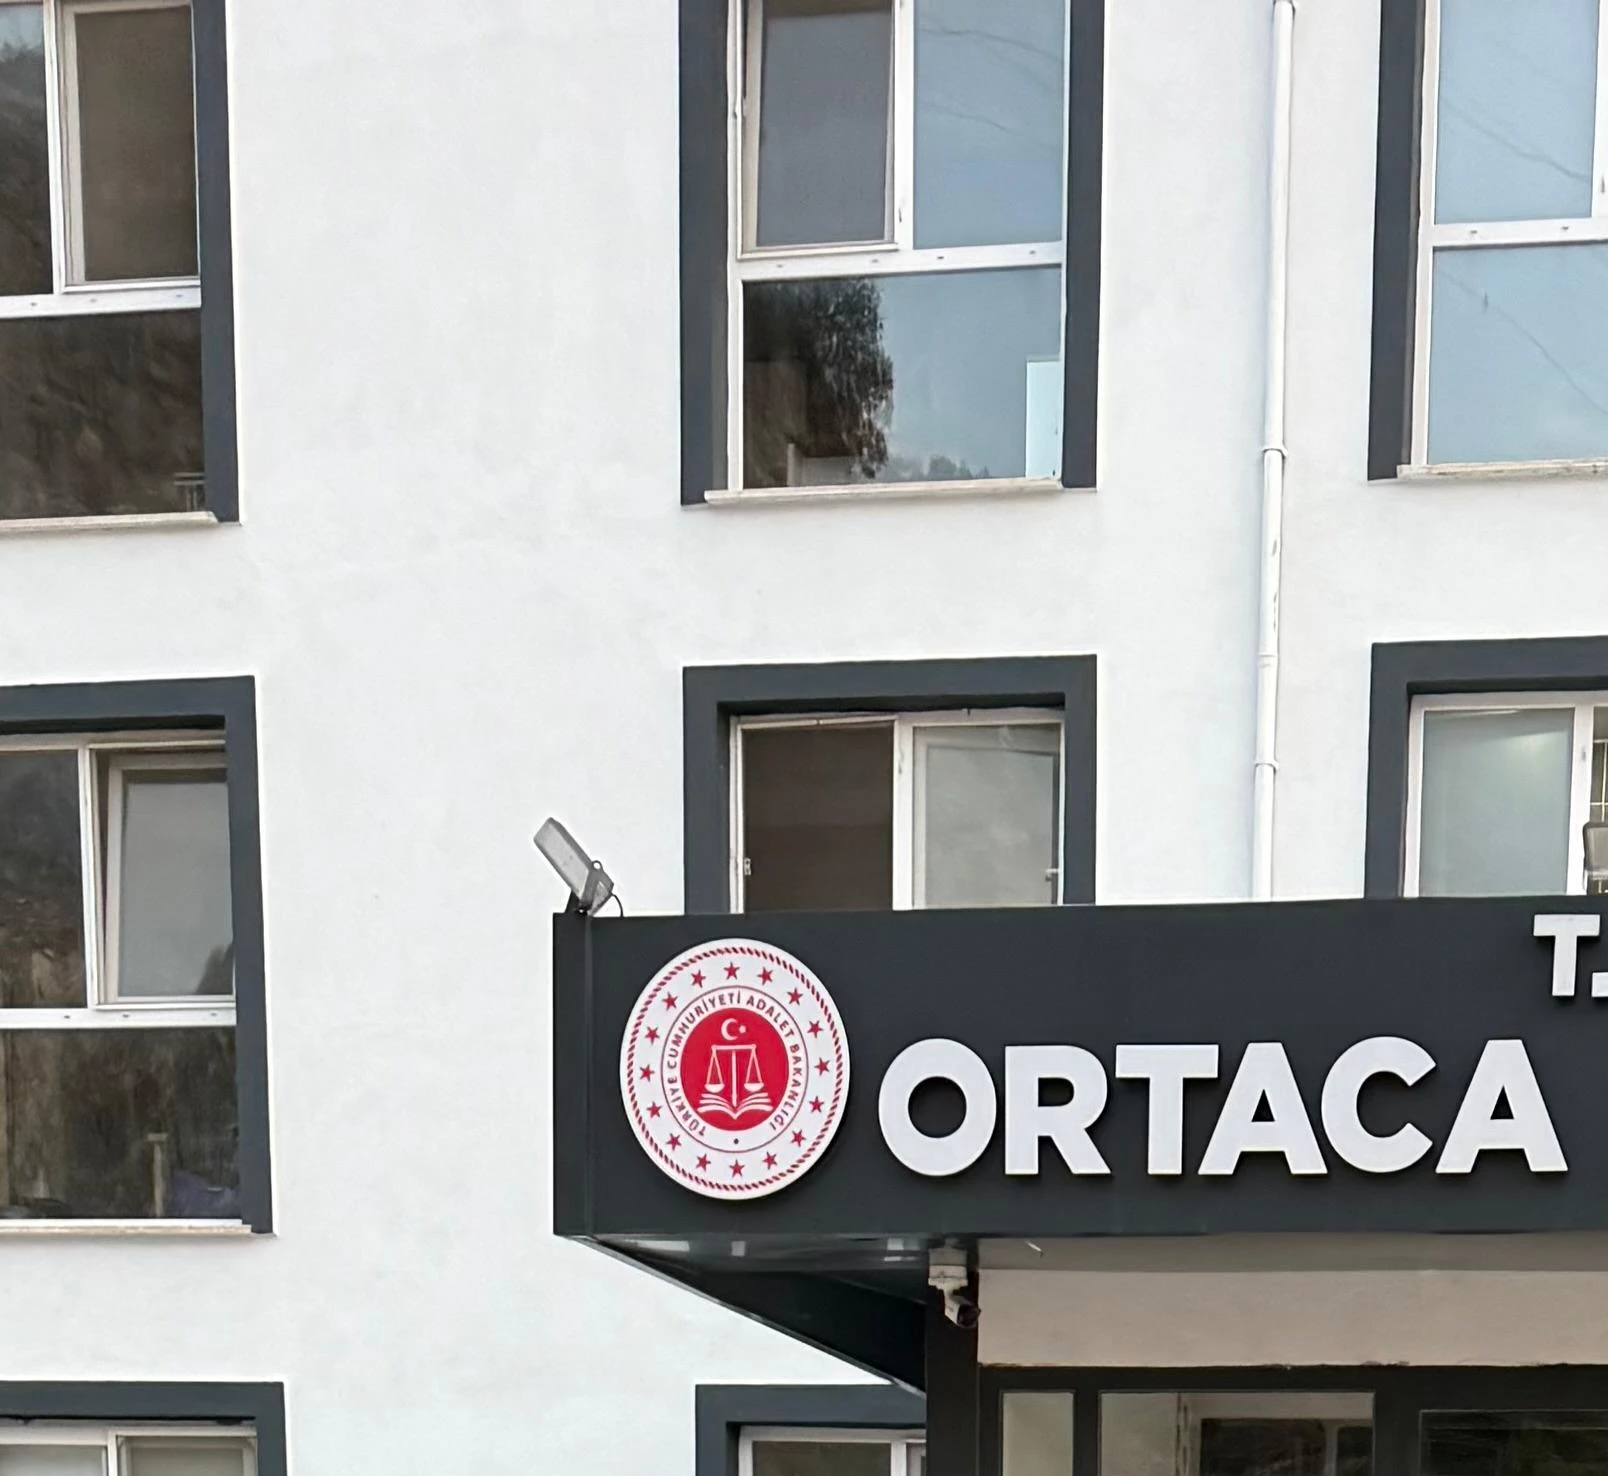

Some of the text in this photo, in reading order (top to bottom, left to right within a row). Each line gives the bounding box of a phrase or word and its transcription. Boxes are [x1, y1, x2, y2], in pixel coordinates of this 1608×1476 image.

[668, 989, 742, 1069] CUMHURİYETİ
[745, 993, 795, 1039] ADALET
[769, 1044, 802, 1131] BAKANLIĞI
[877, 1036, 1569, 1176] ORTACA
